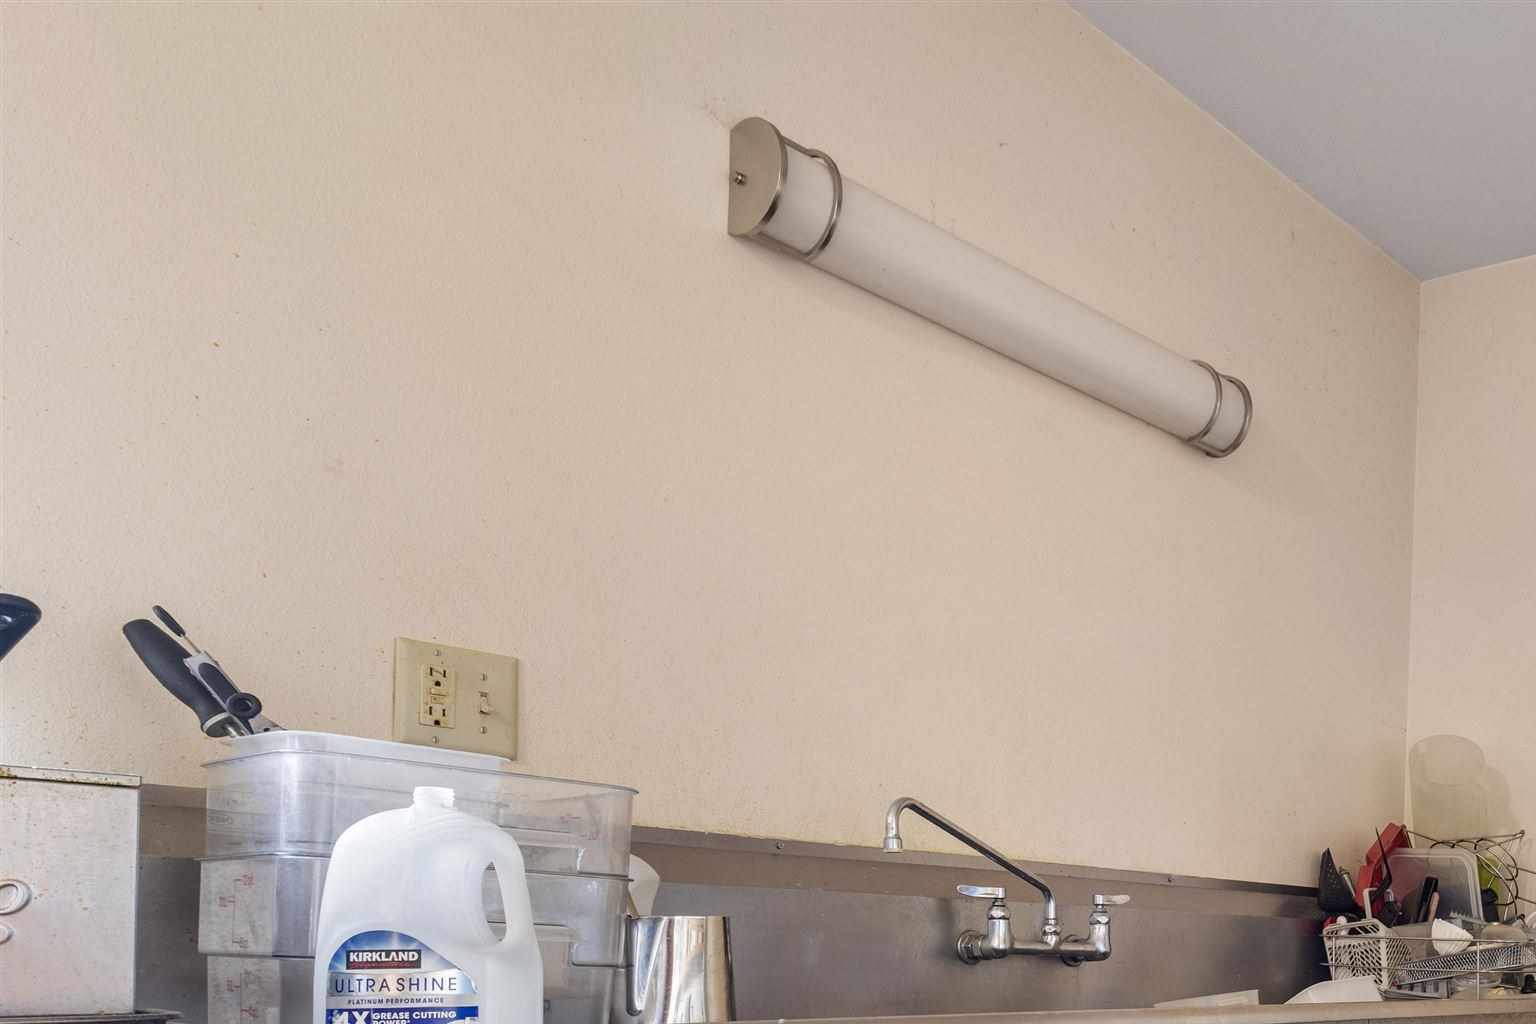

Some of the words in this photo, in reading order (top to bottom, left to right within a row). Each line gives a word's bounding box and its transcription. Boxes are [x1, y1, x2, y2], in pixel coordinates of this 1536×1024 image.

[349, 951, 419, 962] KIRKLAND
[335, 978, 391, 993] ULTRA
[396, 977, 457, 992] SHINE
[385, 997, 444, 1005] PERFORMANCE
[372, 1011, 410, 1020] GREASE
[412, 1011, 457, 1019] CUTTING
